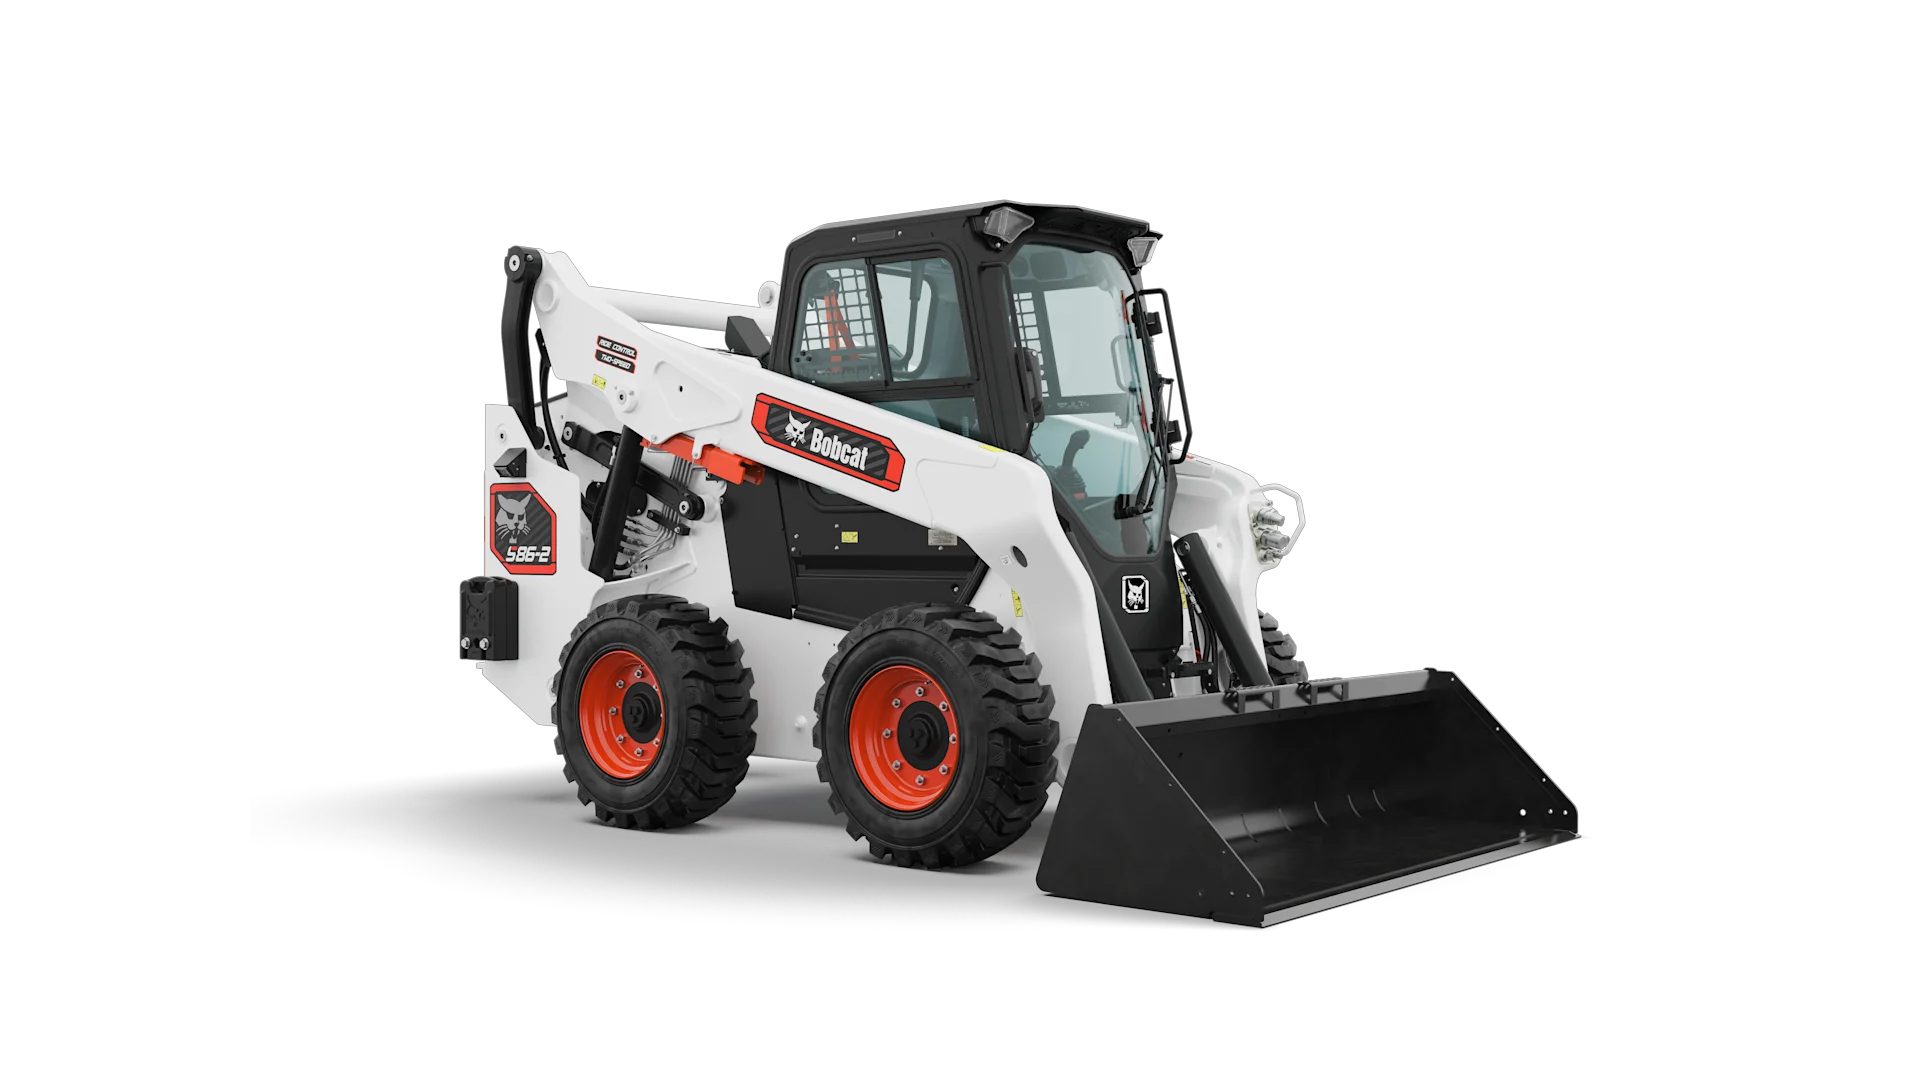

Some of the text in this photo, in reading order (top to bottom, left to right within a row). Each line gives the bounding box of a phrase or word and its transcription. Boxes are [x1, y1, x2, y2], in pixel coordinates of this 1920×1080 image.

[612, 343, 636, 357] CONTROL
[601, 353, 631, 369] TWO-SPEED
[809, 427, 869, 471] Bobcat
